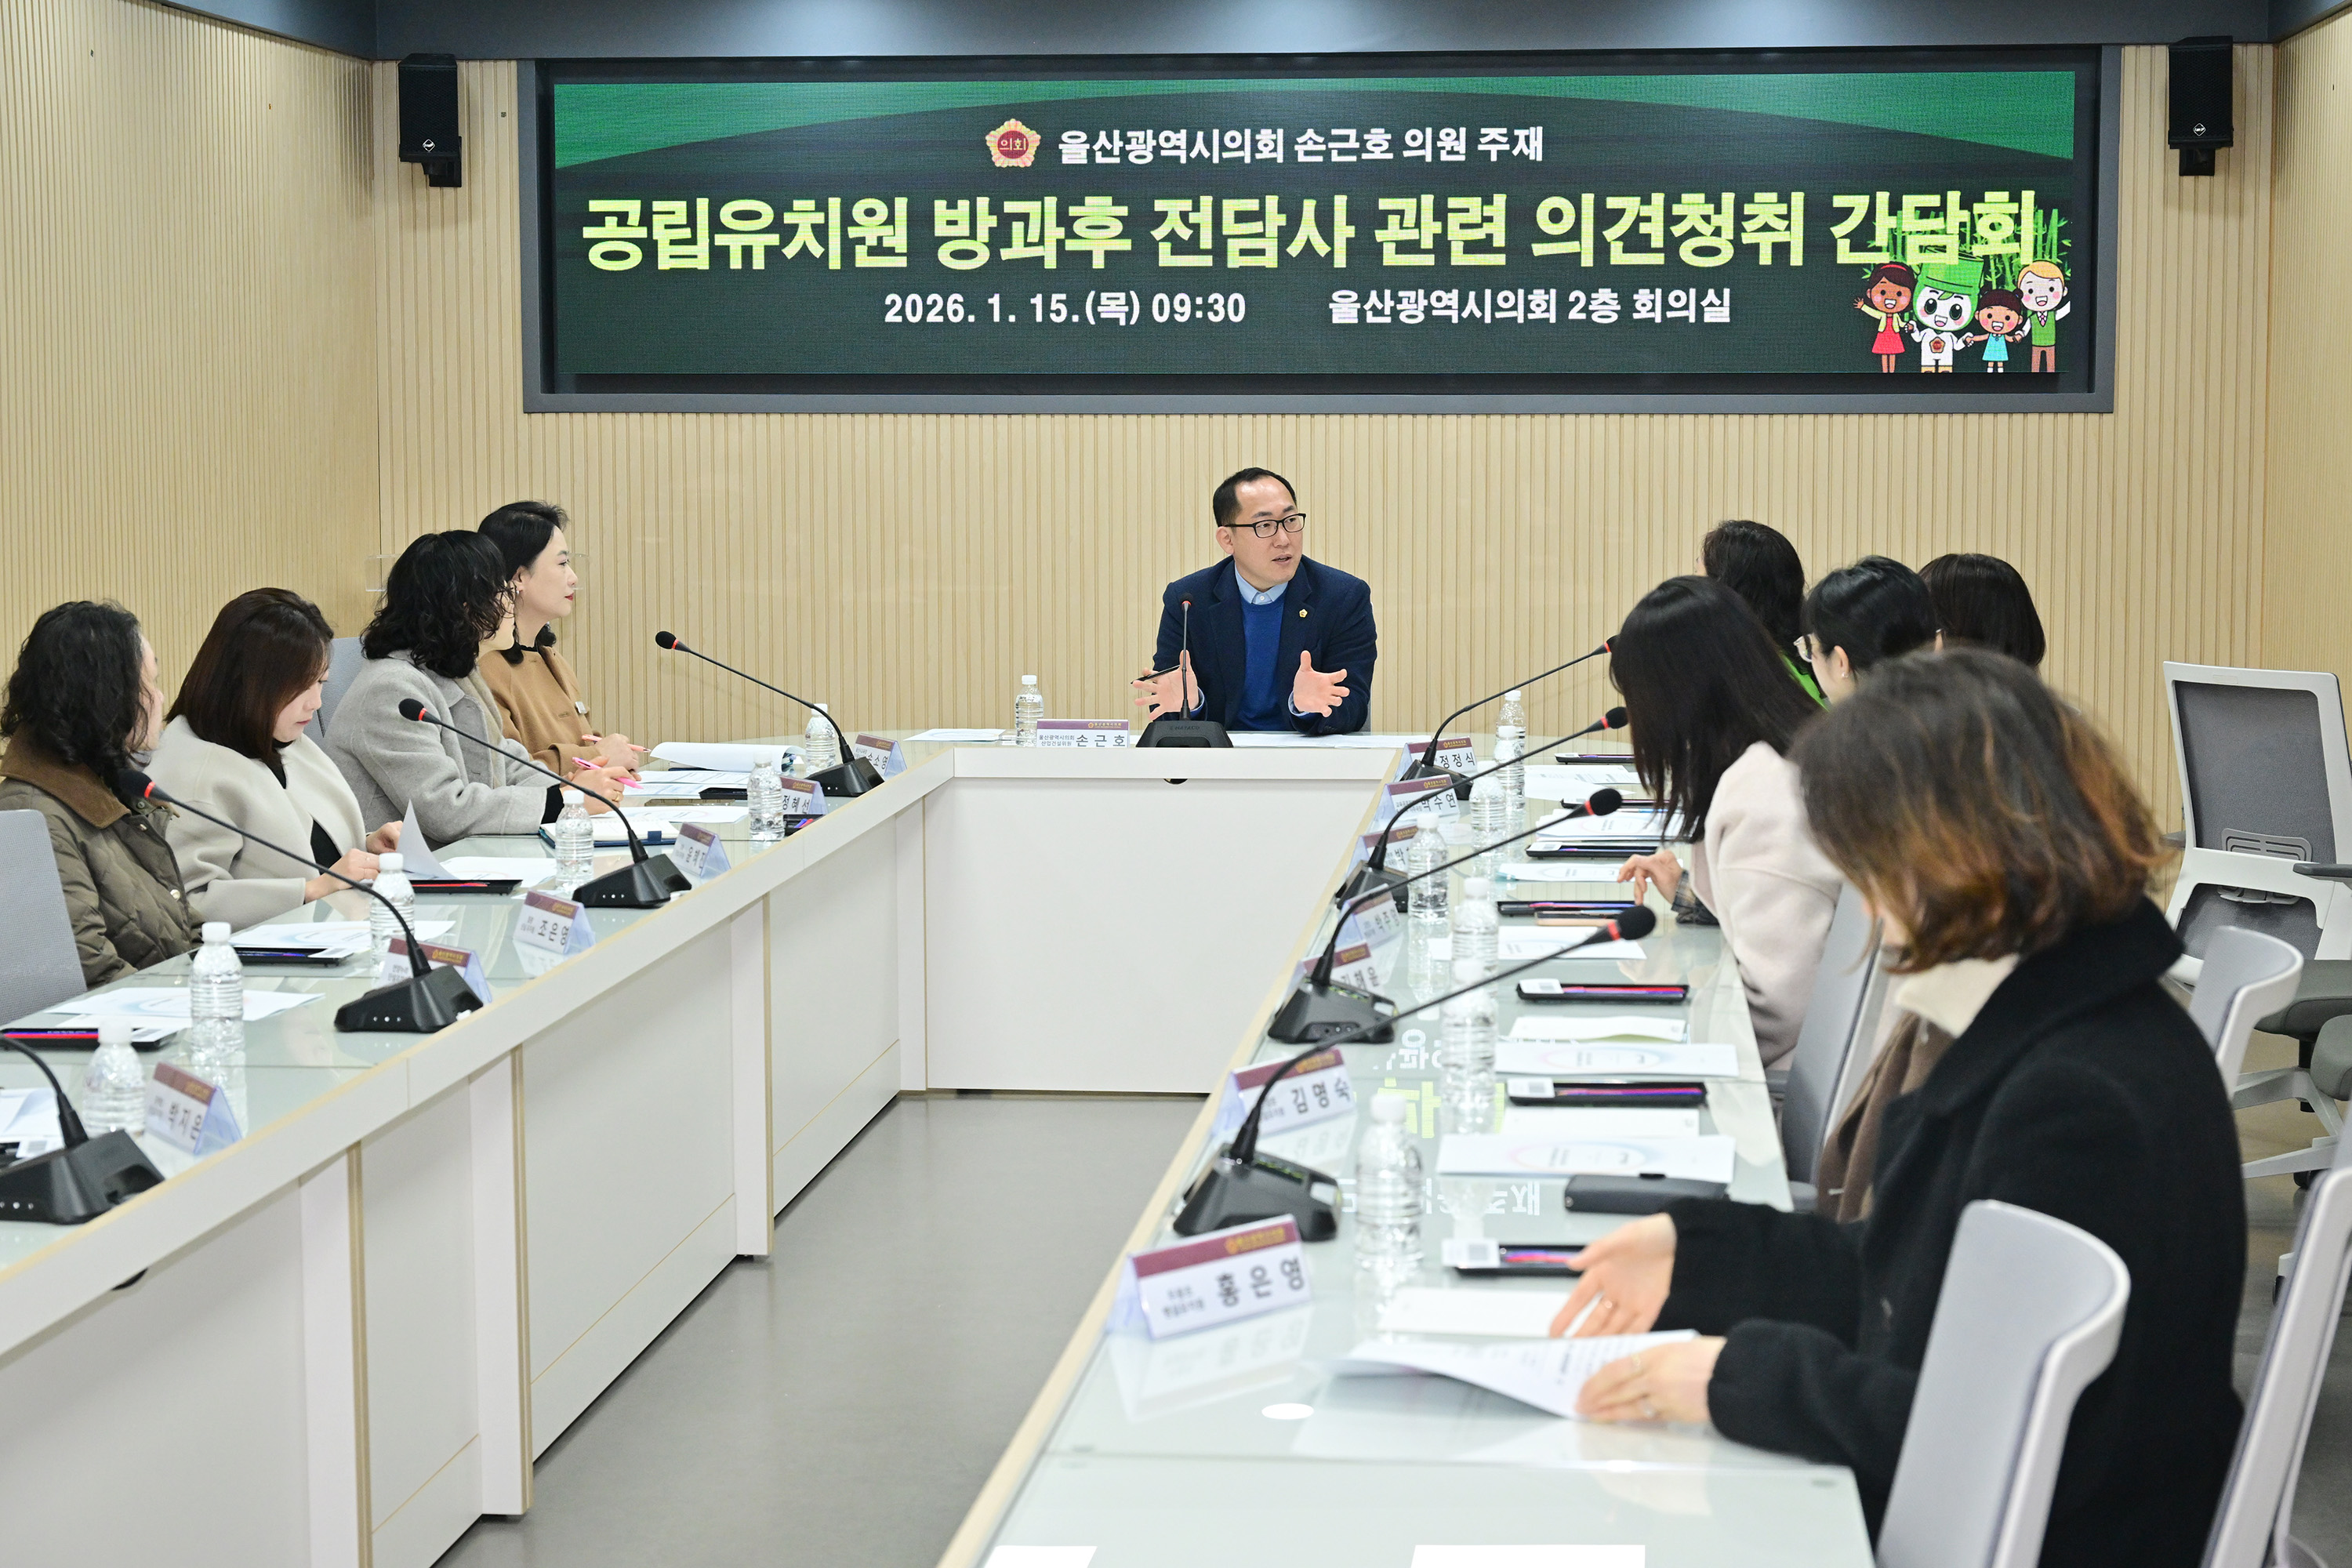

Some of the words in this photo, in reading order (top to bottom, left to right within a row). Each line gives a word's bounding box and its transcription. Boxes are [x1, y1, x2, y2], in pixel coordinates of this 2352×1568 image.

[1000, 137, 1026, 151] 의회
[1059, 129, 1285, 165] 울산광역시의회
[1294, 129, 1395, 163] 손근호
[1403, 128, 1468, 163] 의원
[1478, 126, 1544, 163] 주재
[583, 198, 909, 272] 공립유치원
[934, 197, 1133, 271] 방과후
[1150, 194, 1356, 269] 전담사
[1374, 194, 1508, 267] 관련
[1531, 191, 1804, 267] 의견청취
[1830, 191, 2035, 265] 간담회
[884, 293, 976, 324] 2026.
[987, 294, 1017, 324] 1.
[1030, 291, 1142, 327] 15.(목)
[1152, 293, 1247, 324] 09:30
[1329, 289, 1558, 325] 울산광역시의회
[1569, 289, 1622, 325] 2층
[1633, 289, 1731, 324] 회의실
[1439, 752, 1475, 769] 정정식
[1290, 1077, 1351, 1114] 김명숙
[1215, 1256, 1305, 1308] 홍은영
